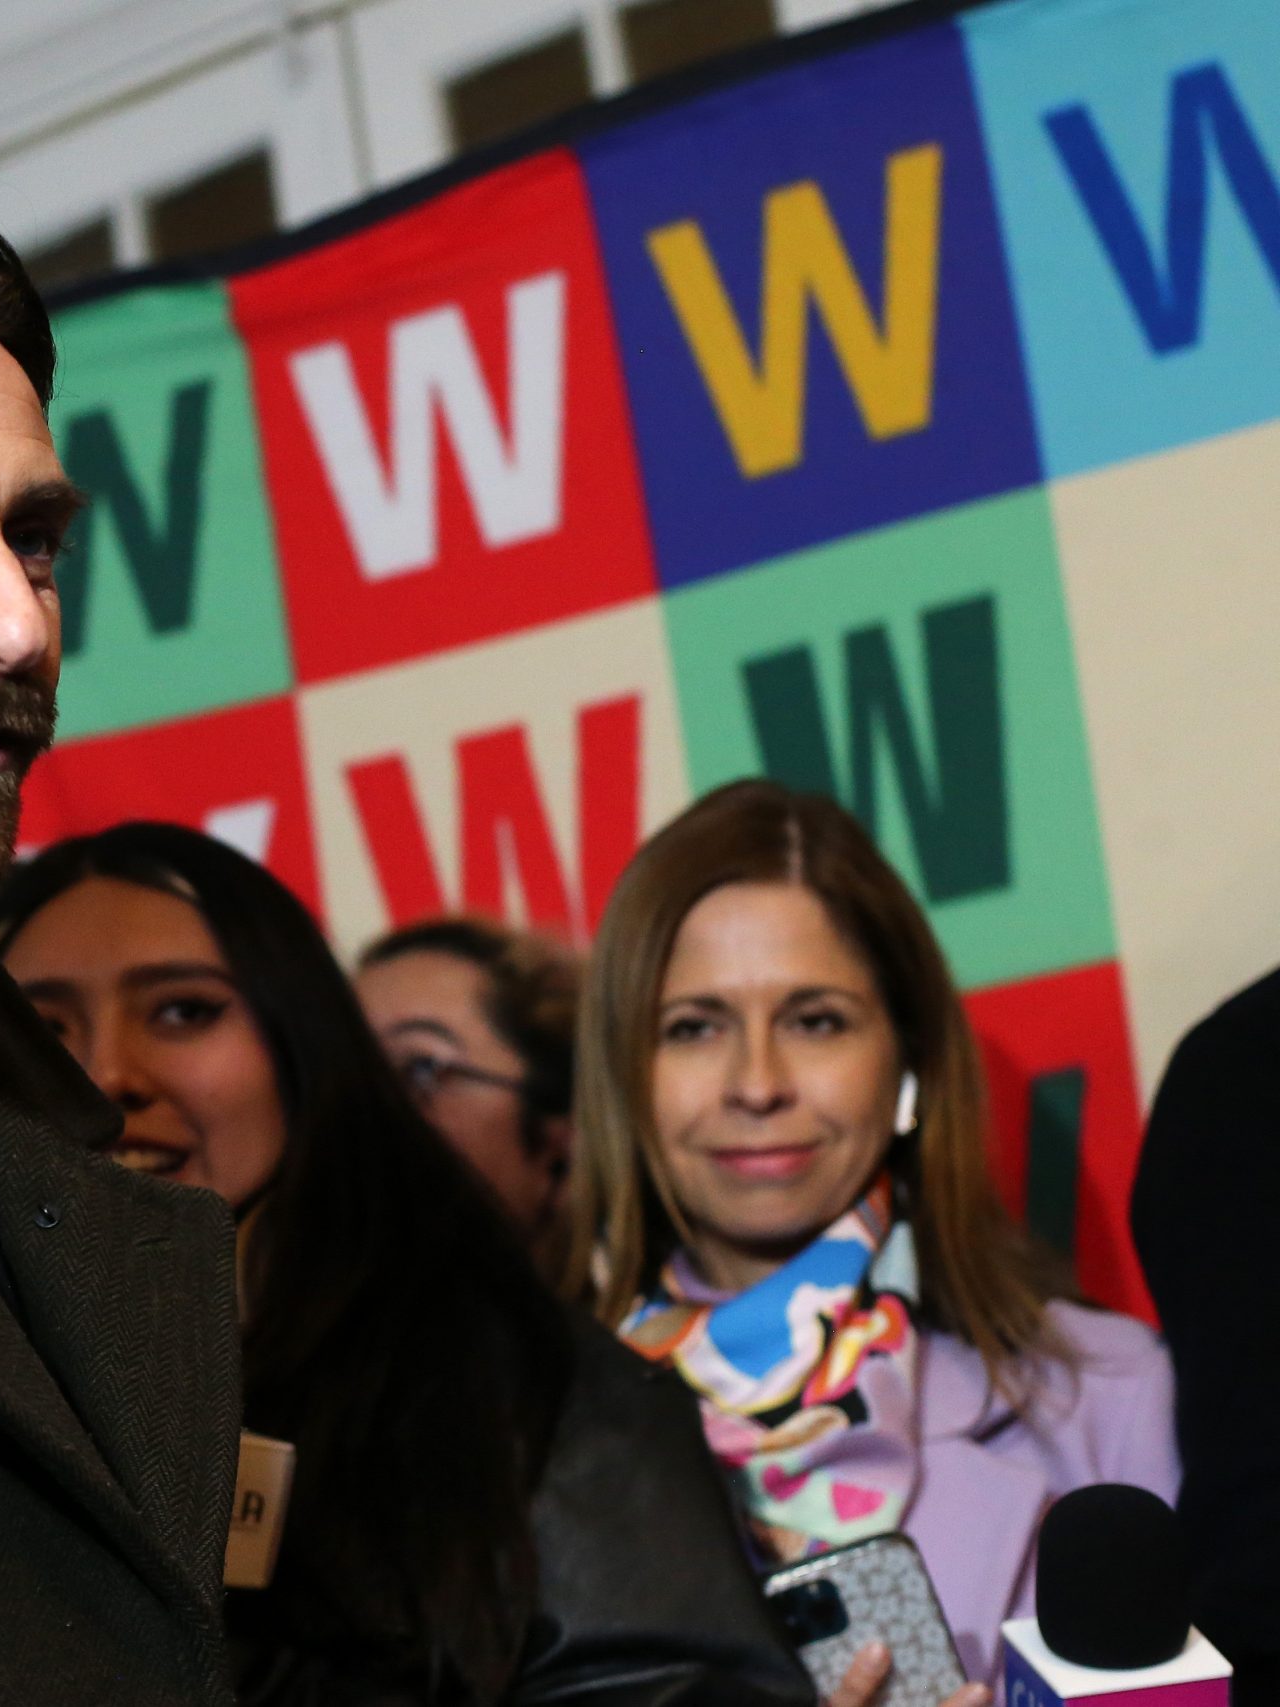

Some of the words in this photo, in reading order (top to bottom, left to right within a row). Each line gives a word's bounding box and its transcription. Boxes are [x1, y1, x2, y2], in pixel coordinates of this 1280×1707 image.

[289, 272, 566, 581] W
[646, 142, 944, 481] W
[341, 691, 642, 940] W
[740, 591, 1013, 906] W
